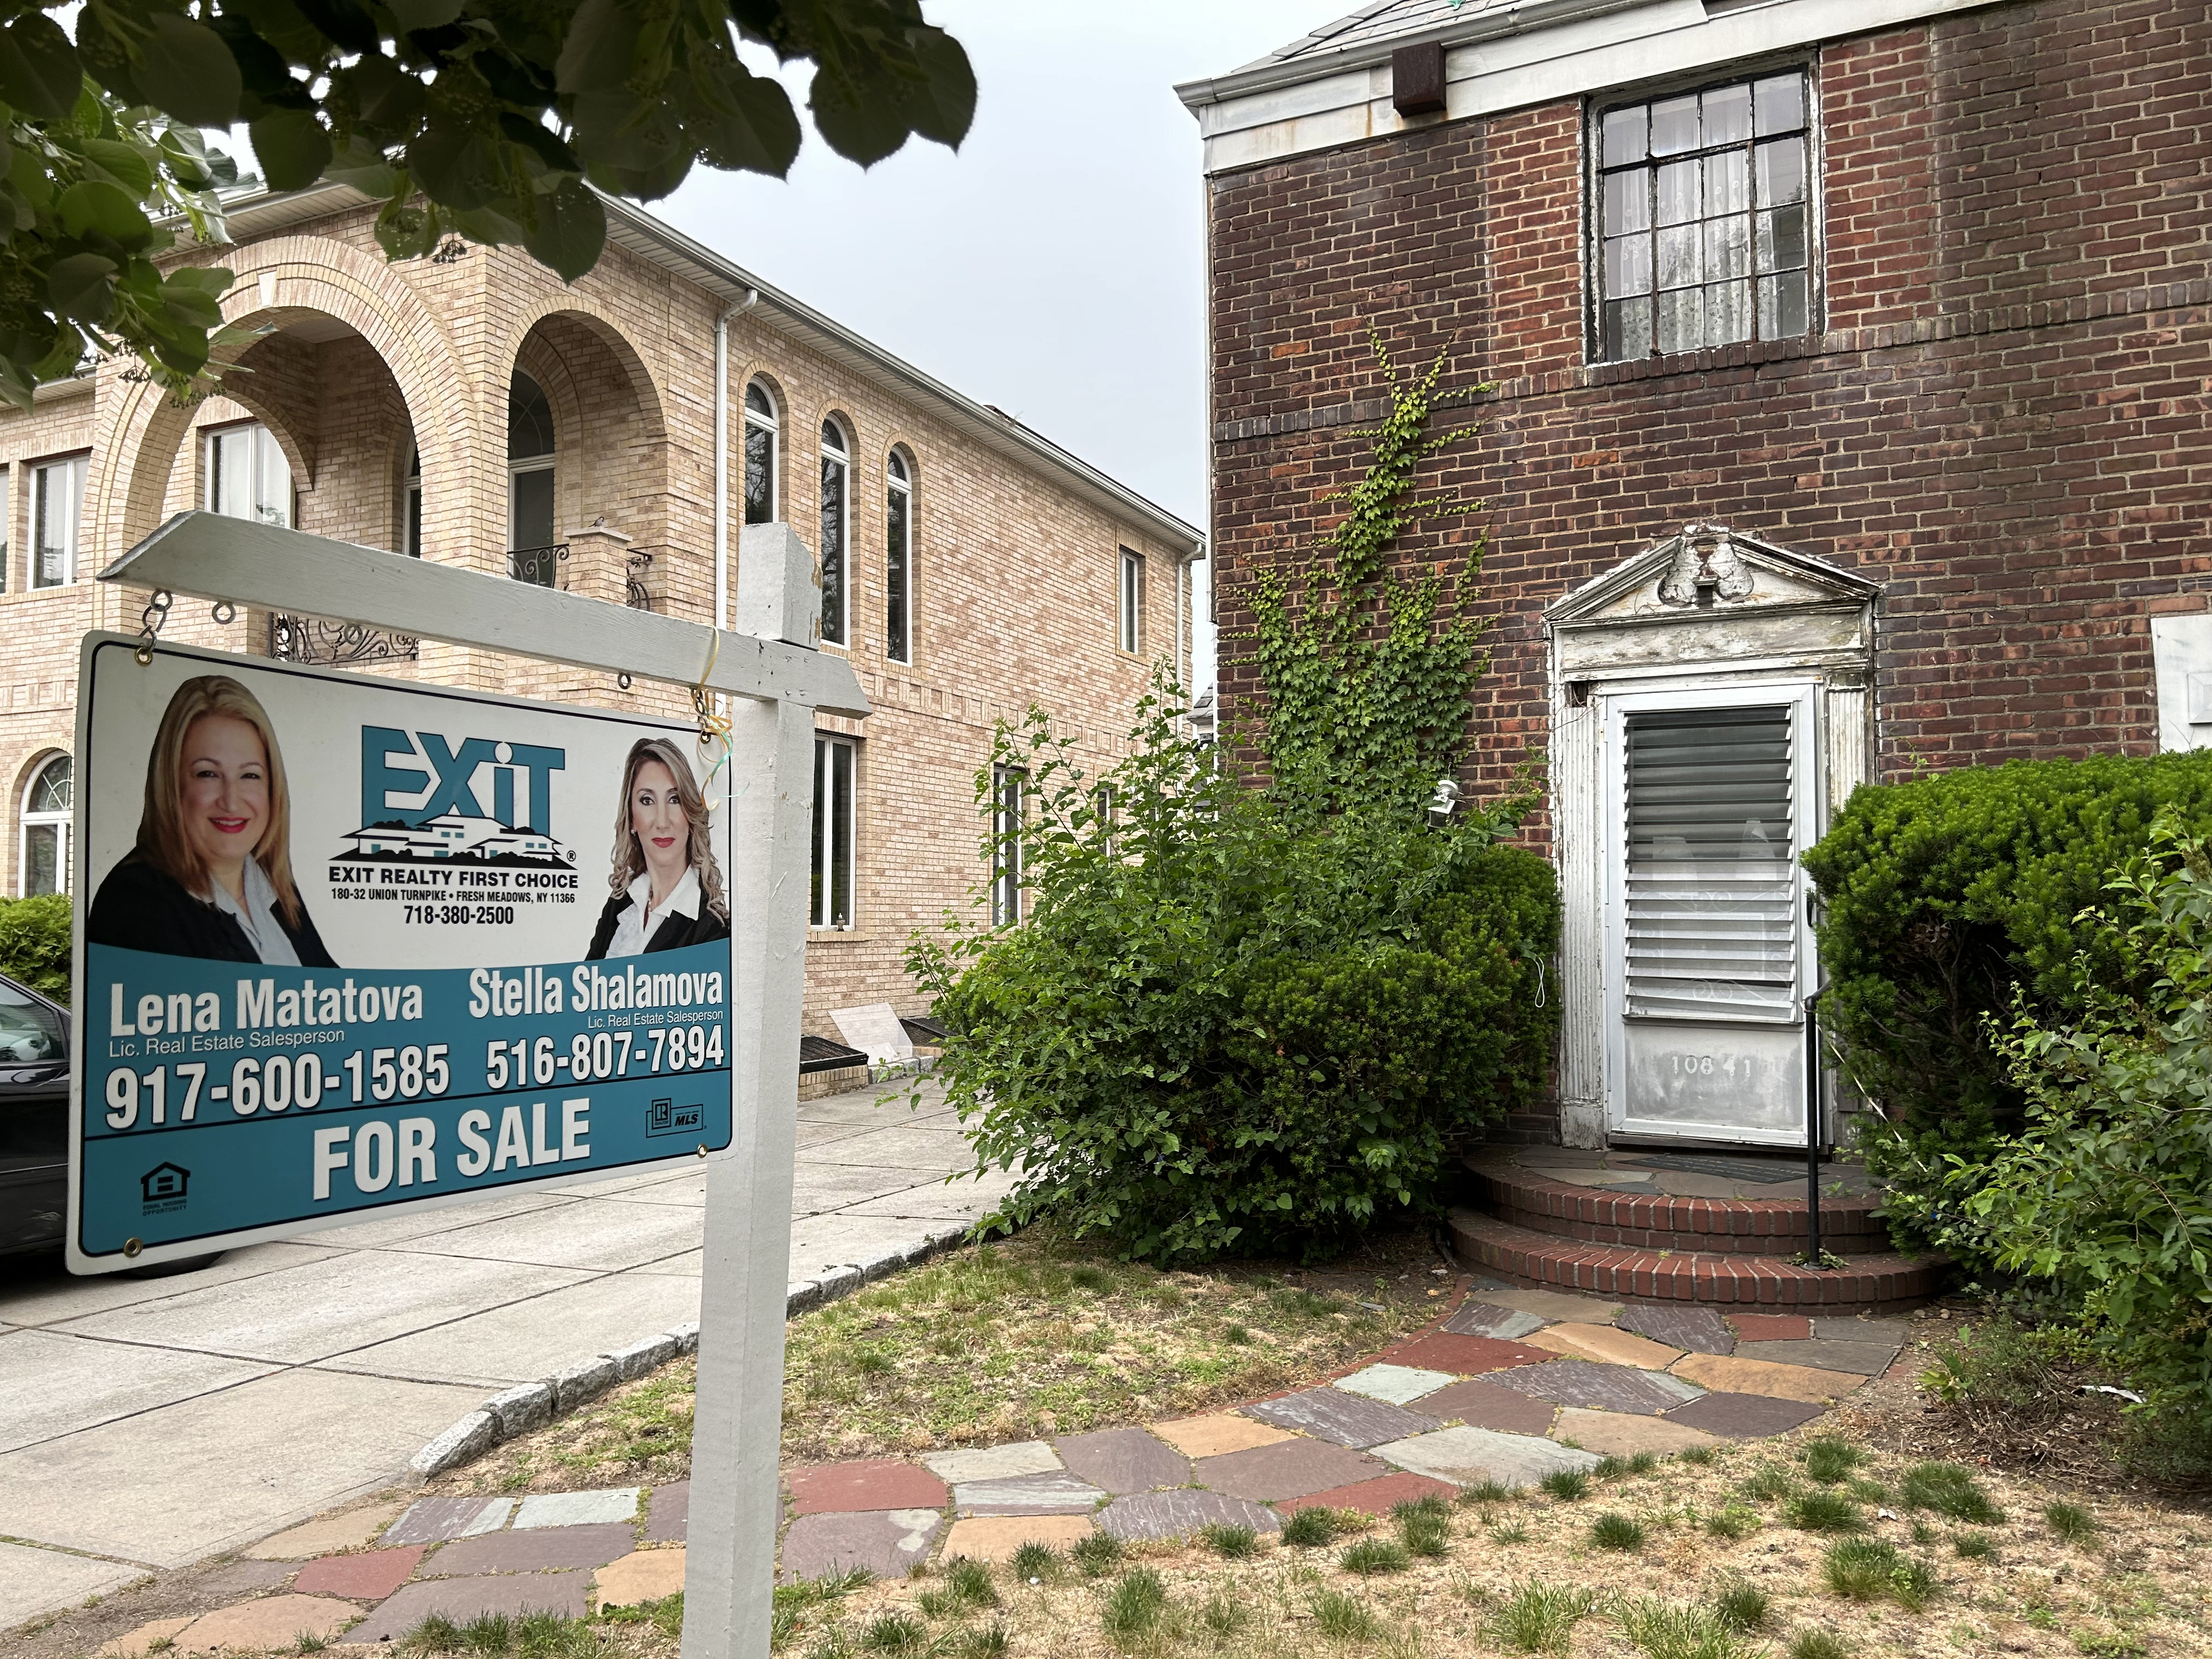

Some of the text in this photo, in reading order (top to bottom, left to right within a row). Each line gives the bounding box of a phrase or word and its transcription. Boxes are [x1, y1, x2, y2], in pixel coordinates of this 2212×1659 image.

[329, 866, 578, 889] EXIT REALTY FIRST CHOICE
[331, 888, 575, 904] 180-32 UNION TURNPIKE FRESH MEADOWS, NY 11366
[404, 905, 514, 924] 718-380-2500
[469, 964, 723, 1018] Stella Shalamova
[111, 978, 424, 1037] Lena Matatova
[588, 1009, 724, 1029] Lic. Real Estate Salesperson
[110, 1029, 345, 1058] Lic. Real Estate Salesperson
[486, 1024, 725, 1090] 516-807-7894
[105, 1043, 450, 1130] 917-600-1585
[674, 1113, 698, 1126] MLS
[313, 1098, 590, 1201] FOR SALE
